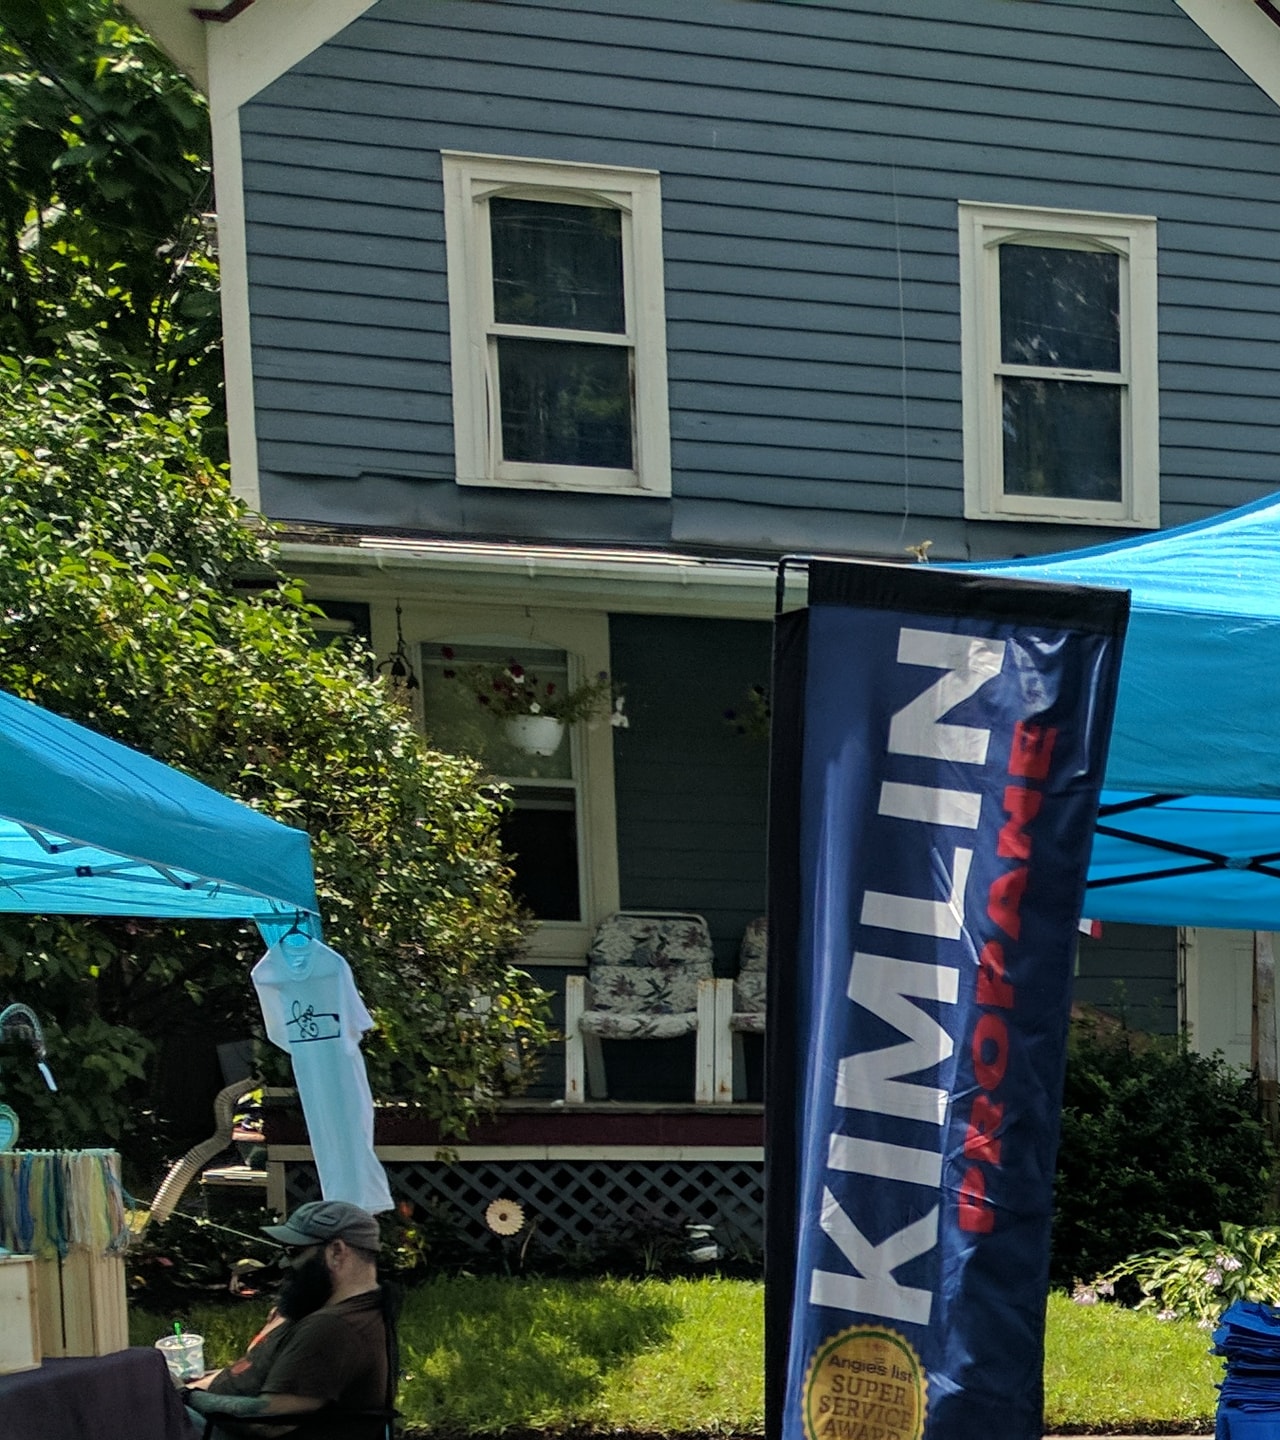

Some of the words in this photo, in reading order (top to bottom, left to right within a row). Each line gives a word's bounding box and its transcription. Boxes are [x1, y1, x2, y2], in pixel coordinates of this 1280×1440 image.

[810, 627, 1006, 1325] KIMLIN
[958, 721, 1057, 1233] PROPANE
[831, 1373, 907, 1406] SUPER
[891, 1364, 914, 1384] list
[818, 1395, 912, 1432] SERVICE
